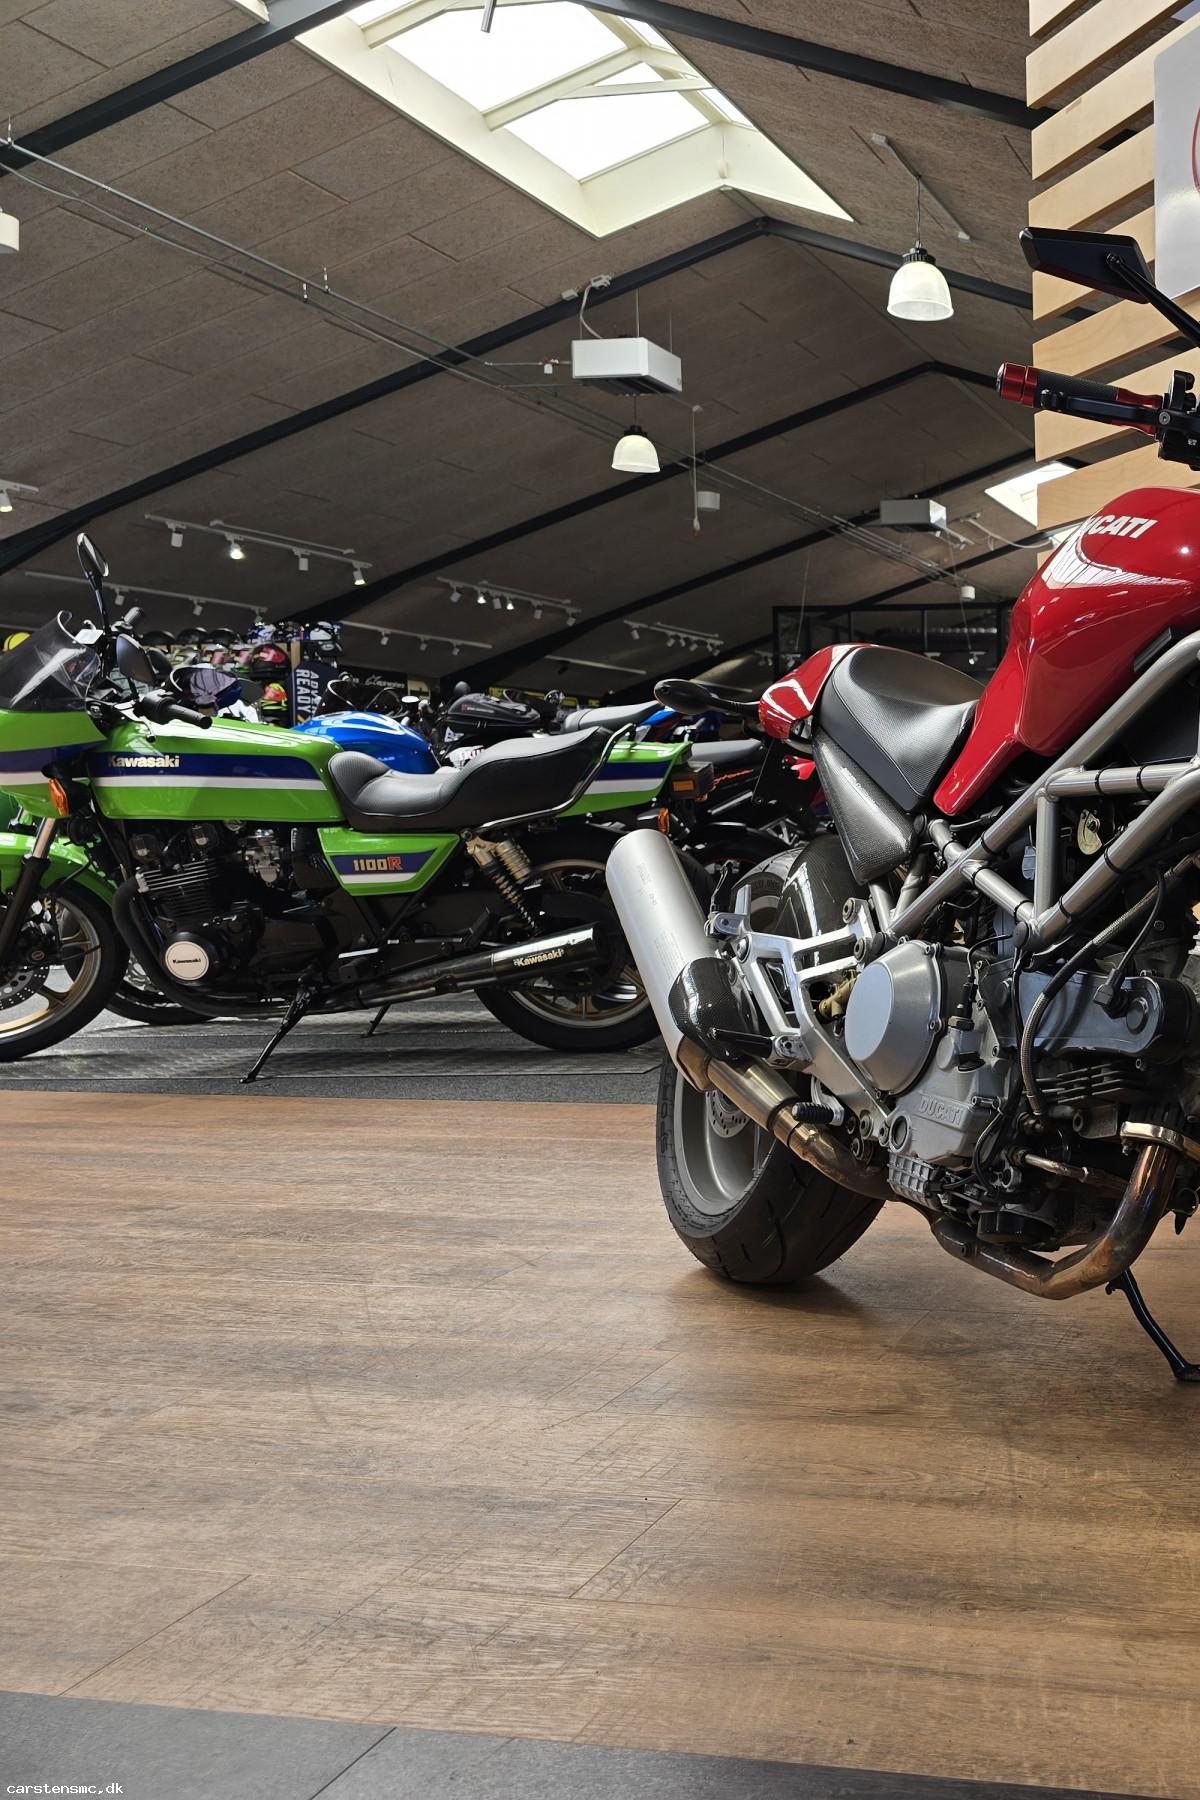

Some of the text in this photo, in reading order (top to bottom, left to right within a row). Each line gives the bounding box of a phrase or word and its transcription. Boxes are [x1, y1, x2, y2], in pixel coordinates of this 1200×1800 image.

[1085, 514, 1158, 539] UCATI
[296, 669, 310, 713] READY
[108, 755, 180, 768] Kawasaki
[353, 856, 403, 871] 1100R
[517, 948, 563, 967] Kawasaki
[919, 1096, 962, 1126] DUCATI
